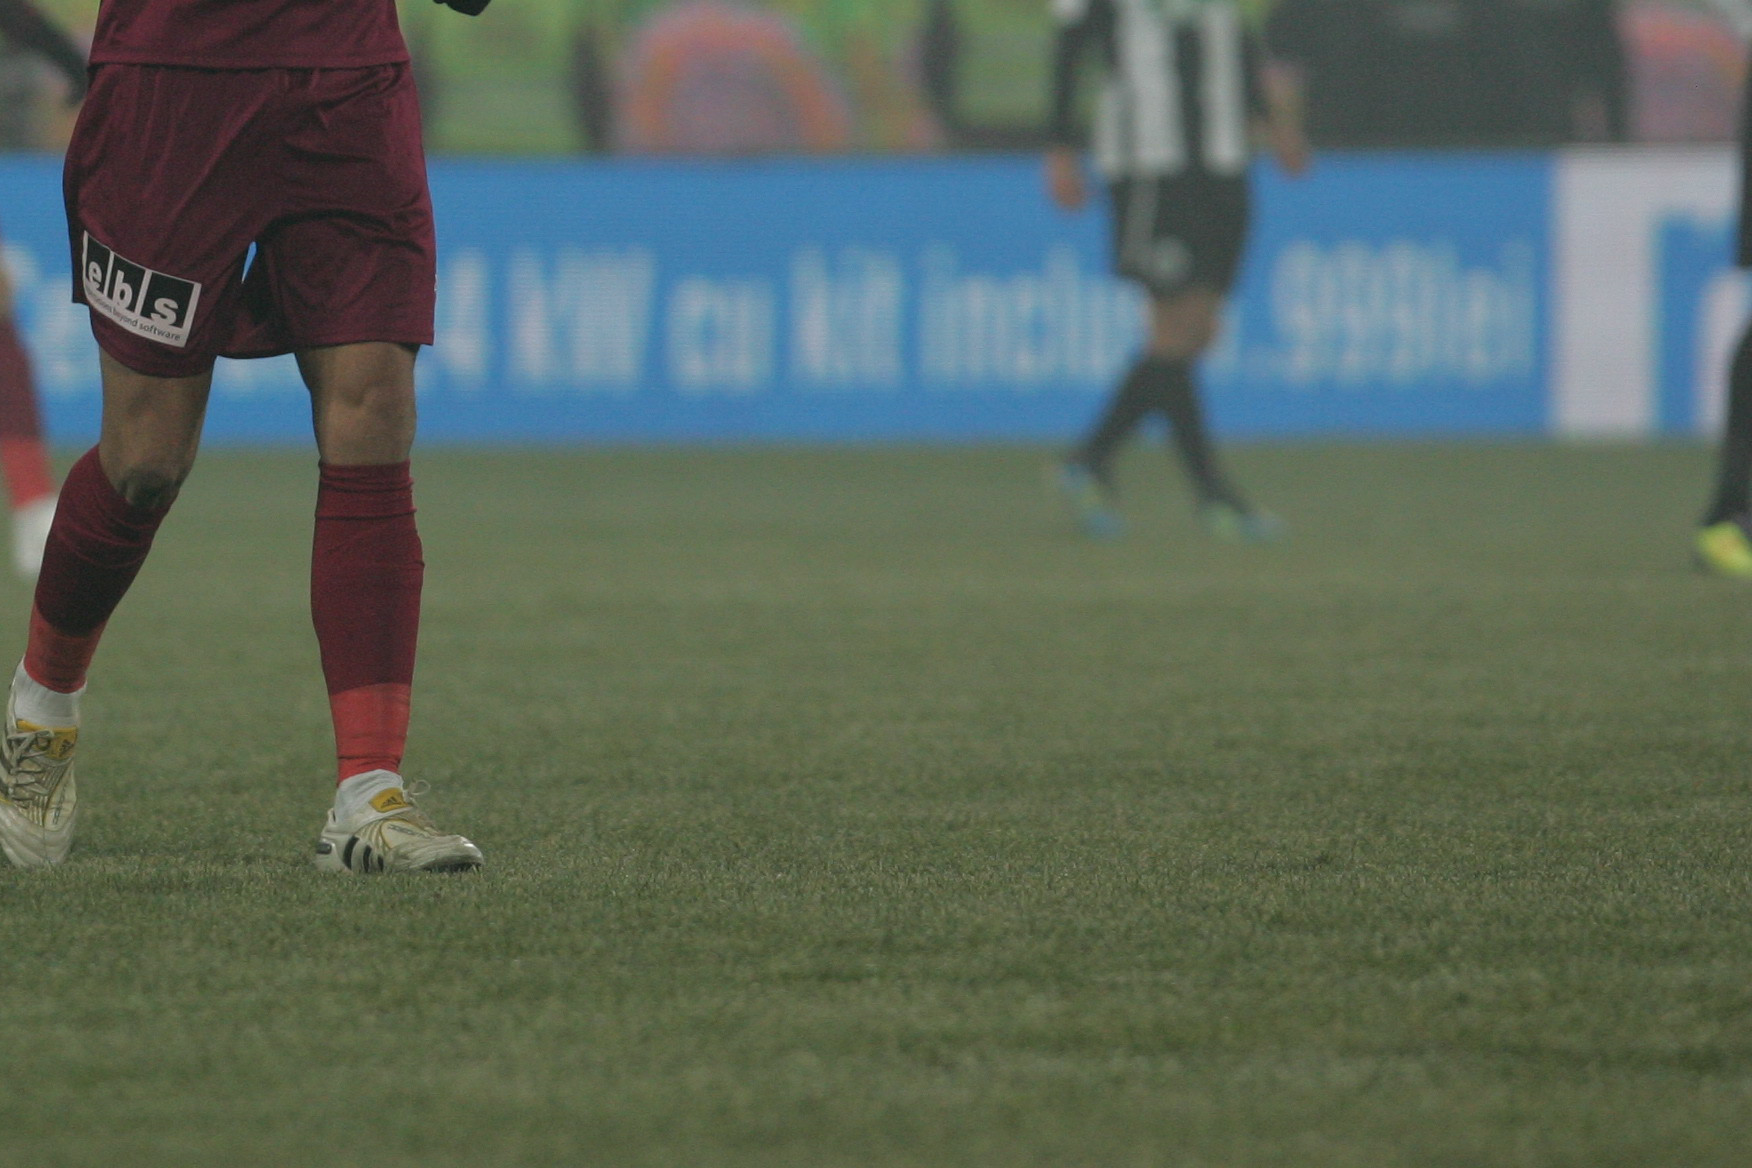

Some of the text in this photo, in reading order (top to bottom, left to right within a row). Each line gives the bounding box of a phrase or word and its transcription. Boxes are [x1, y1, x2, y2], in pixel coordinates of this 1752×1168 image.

[88, 261, 179, 326] ebs
[918, 239, 1156, 389] inclu
[139, 322, 181, 342] software
